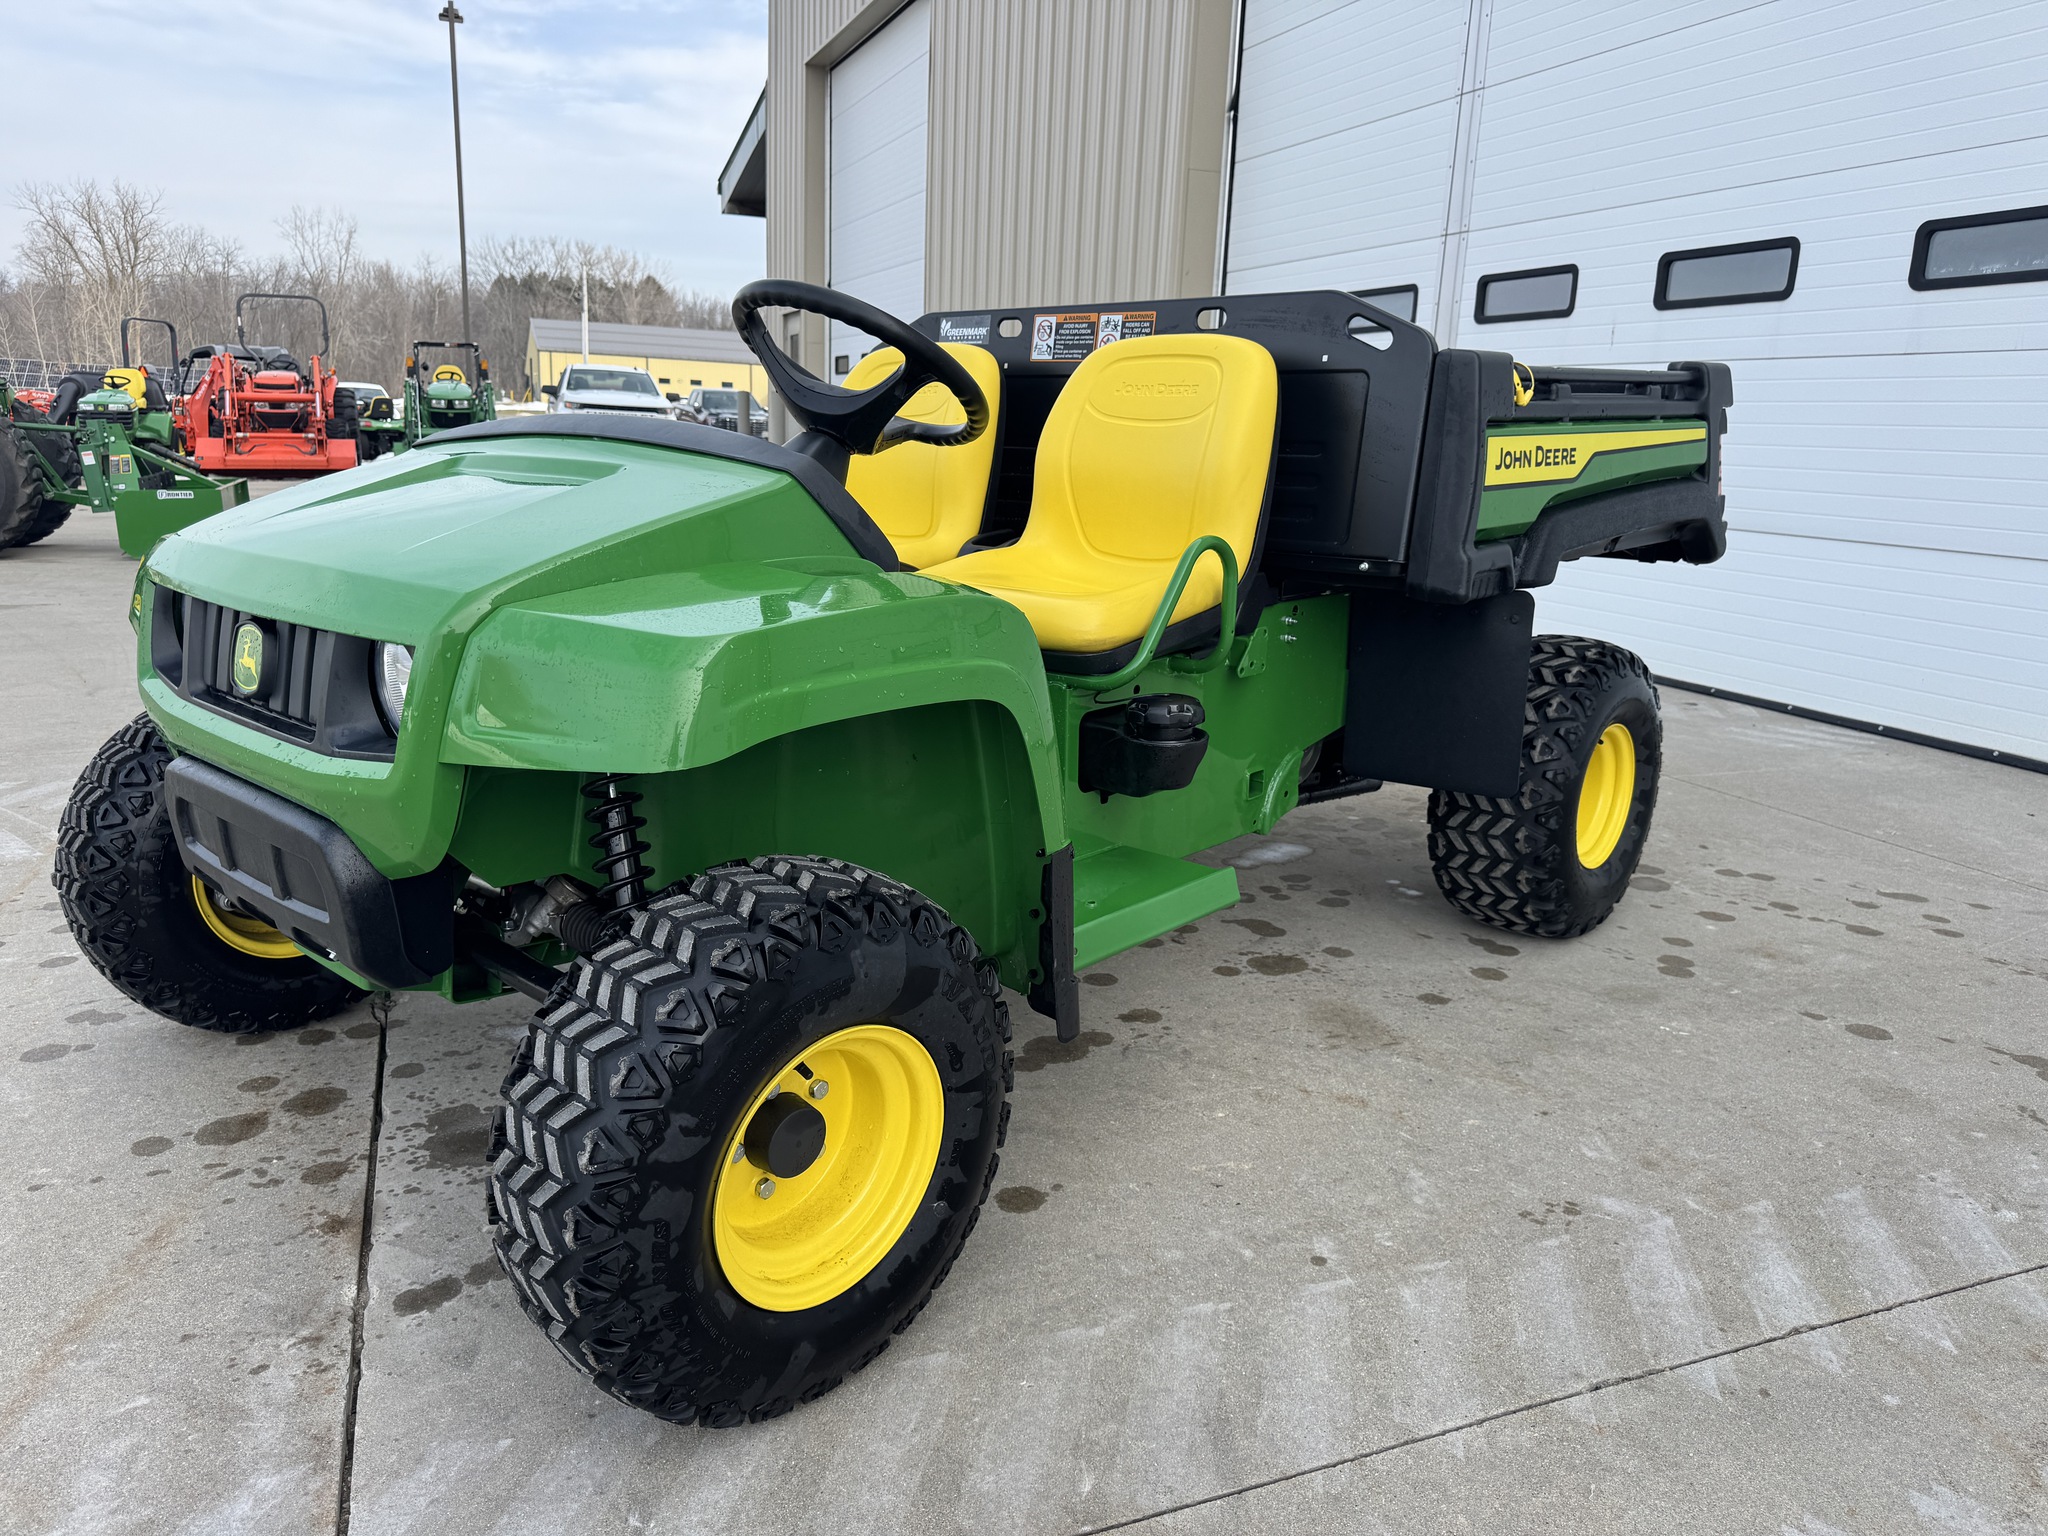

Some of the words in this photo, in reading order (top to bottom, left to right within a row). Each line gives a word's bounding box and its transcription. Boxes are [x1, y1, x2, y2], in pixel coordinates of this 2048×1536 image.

[947, 327, 988, 336] GREENMARK
[1115, 382, 1154, 396] JOHN
[1155, 383, 1199, 396] DEERE
[1495, 447, 1532, 471] JOHN
[1535, 446, 1577, 467] DEERE
